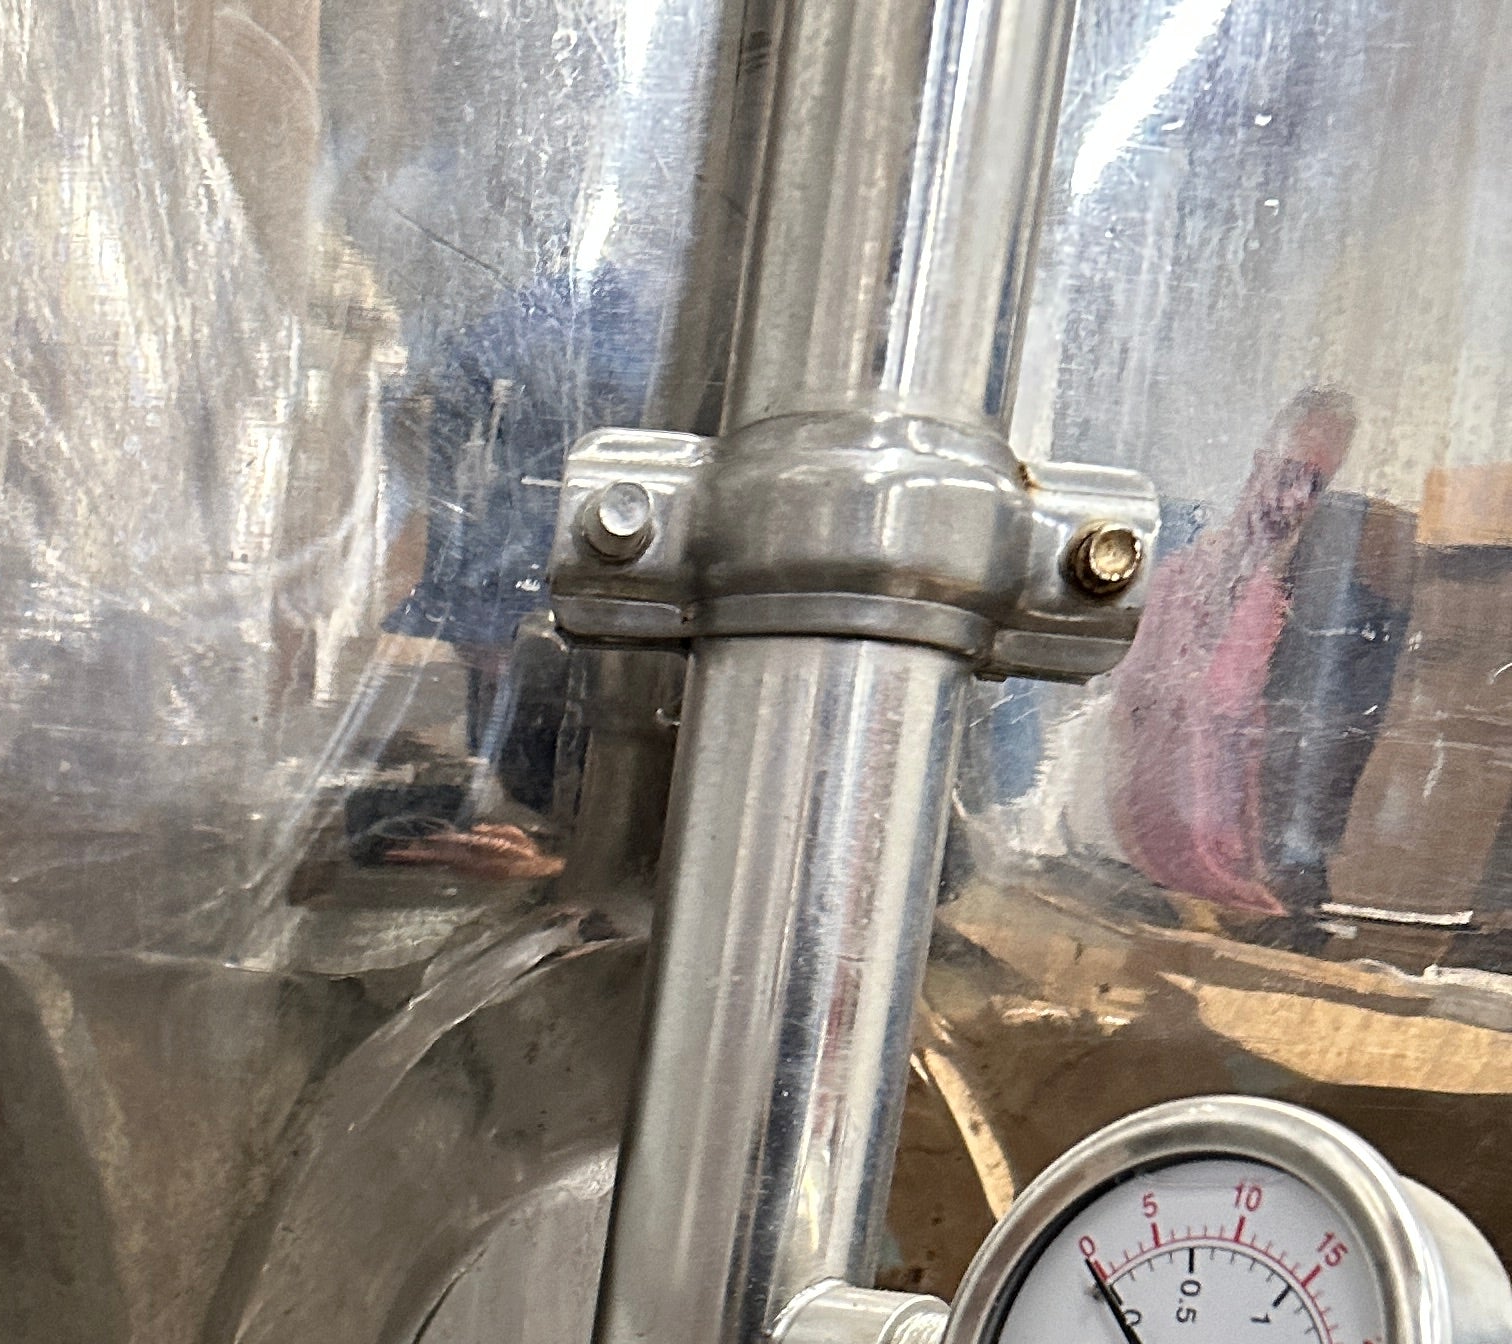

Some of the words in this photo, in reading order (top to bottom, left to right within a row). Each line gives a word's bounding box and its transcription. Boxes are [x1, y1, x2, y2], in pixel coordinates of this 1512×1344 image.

[1142, 1192, 1158, 1218] 5
[1234, 1183, 1263, 1212] 10
[1078, 1235, 1096, 1258] 0
[1315, 1231, 1349, 1268] 15
[1175, 1280, 1201, 1324] 0.5
[1250, 1312, 1272, 1326] 1
